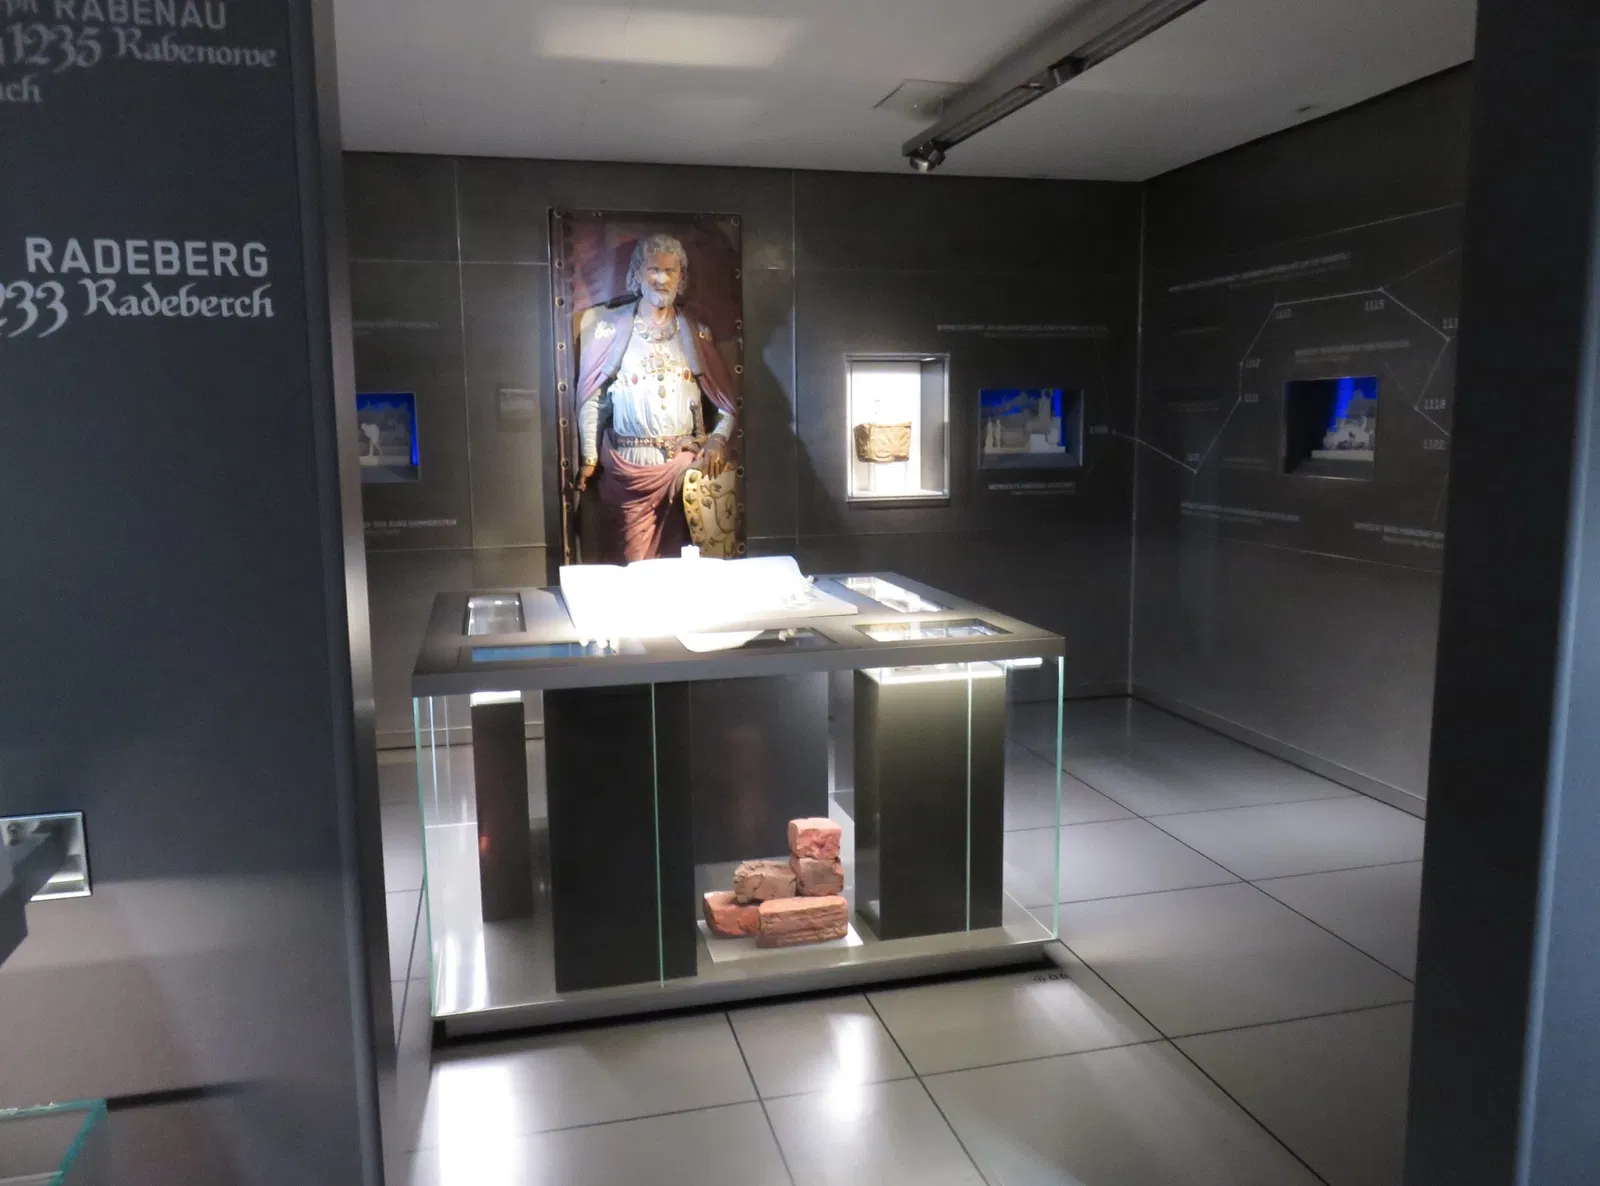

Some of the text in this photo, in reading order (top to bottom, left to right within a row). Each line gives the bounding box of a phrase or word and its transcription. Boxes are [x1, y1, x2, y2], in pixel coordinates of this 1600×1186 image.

[54, 0, 227, 31] RABENAU
[6, 22, 103, 75] 1235
[0, 73, 44, 104] ch
[25, 235, 269, 278] RADEBERG
[77, 278, 276, 319] Radeberch
